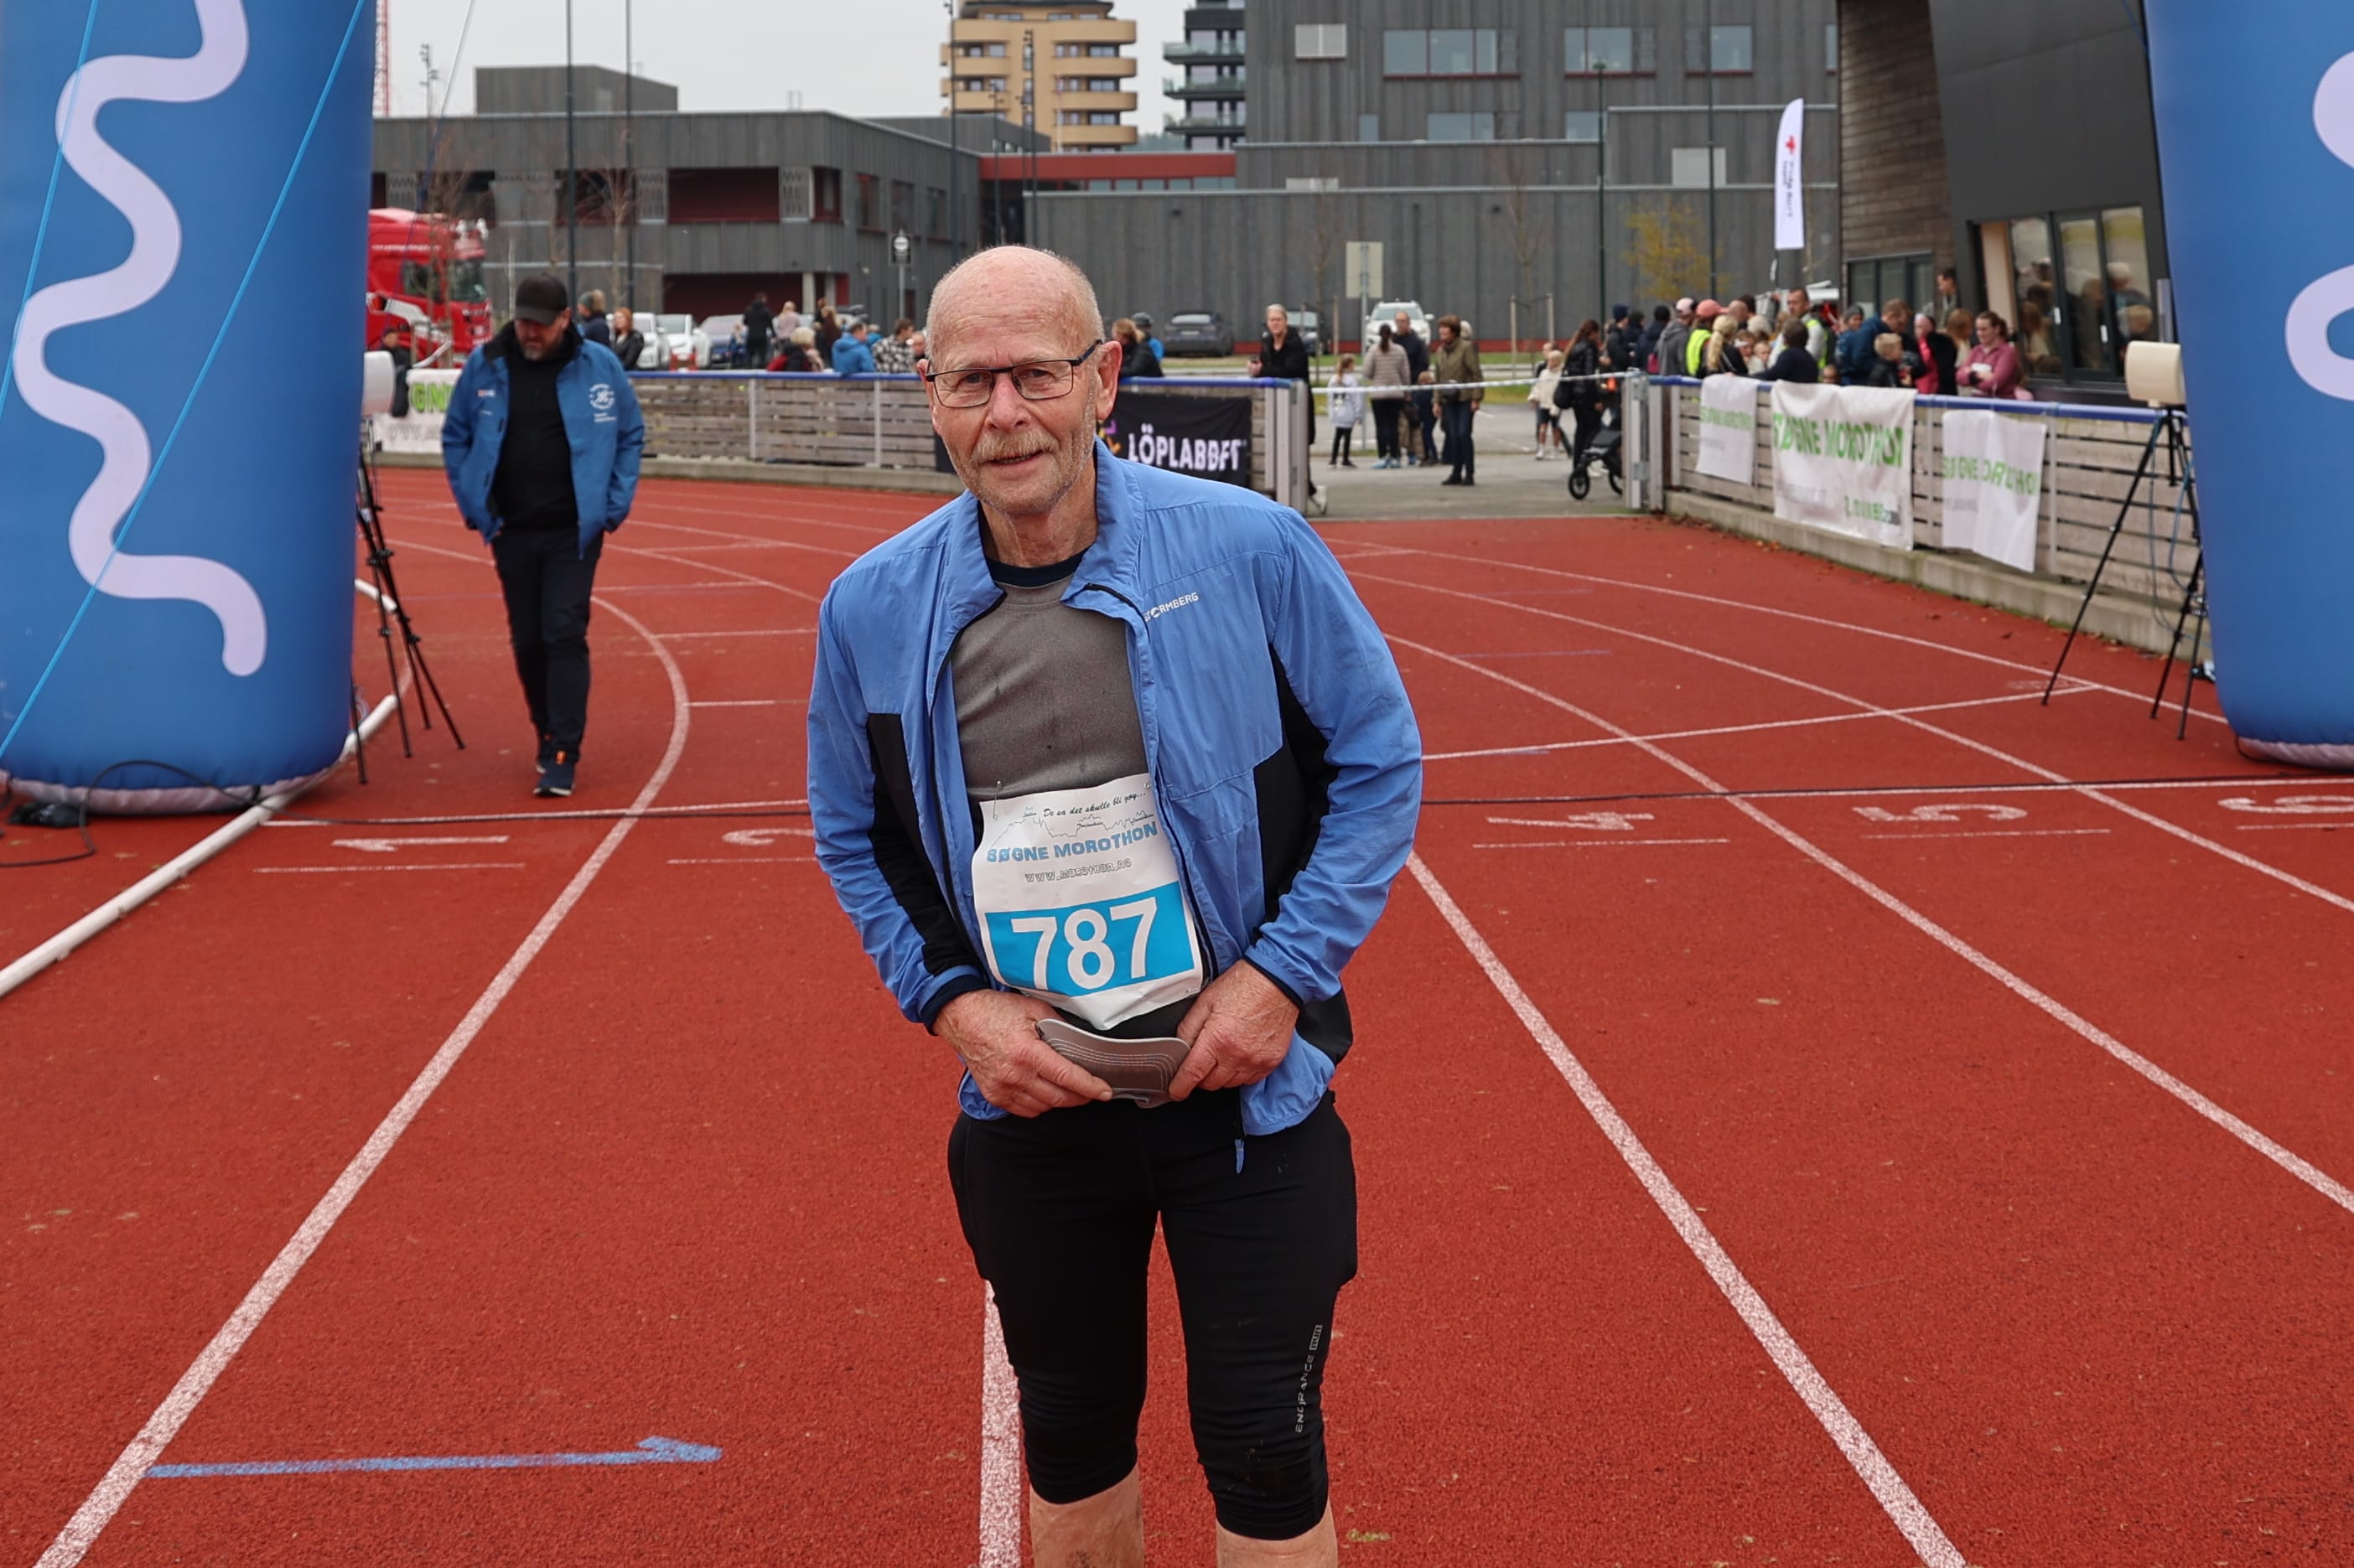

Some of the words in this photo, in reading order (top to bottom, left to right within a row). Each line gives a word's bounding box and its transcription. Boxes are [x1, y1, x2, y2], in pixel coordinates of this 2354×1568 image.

[1085, 801, 1111, 813] skulle
[1112, 796, 1122, 805] bli
[987, 846, 1050, 863] SØGNE
[1053, 821, 1159, 859] MOROTHON
[1010, 897, 1158, 991] 787
